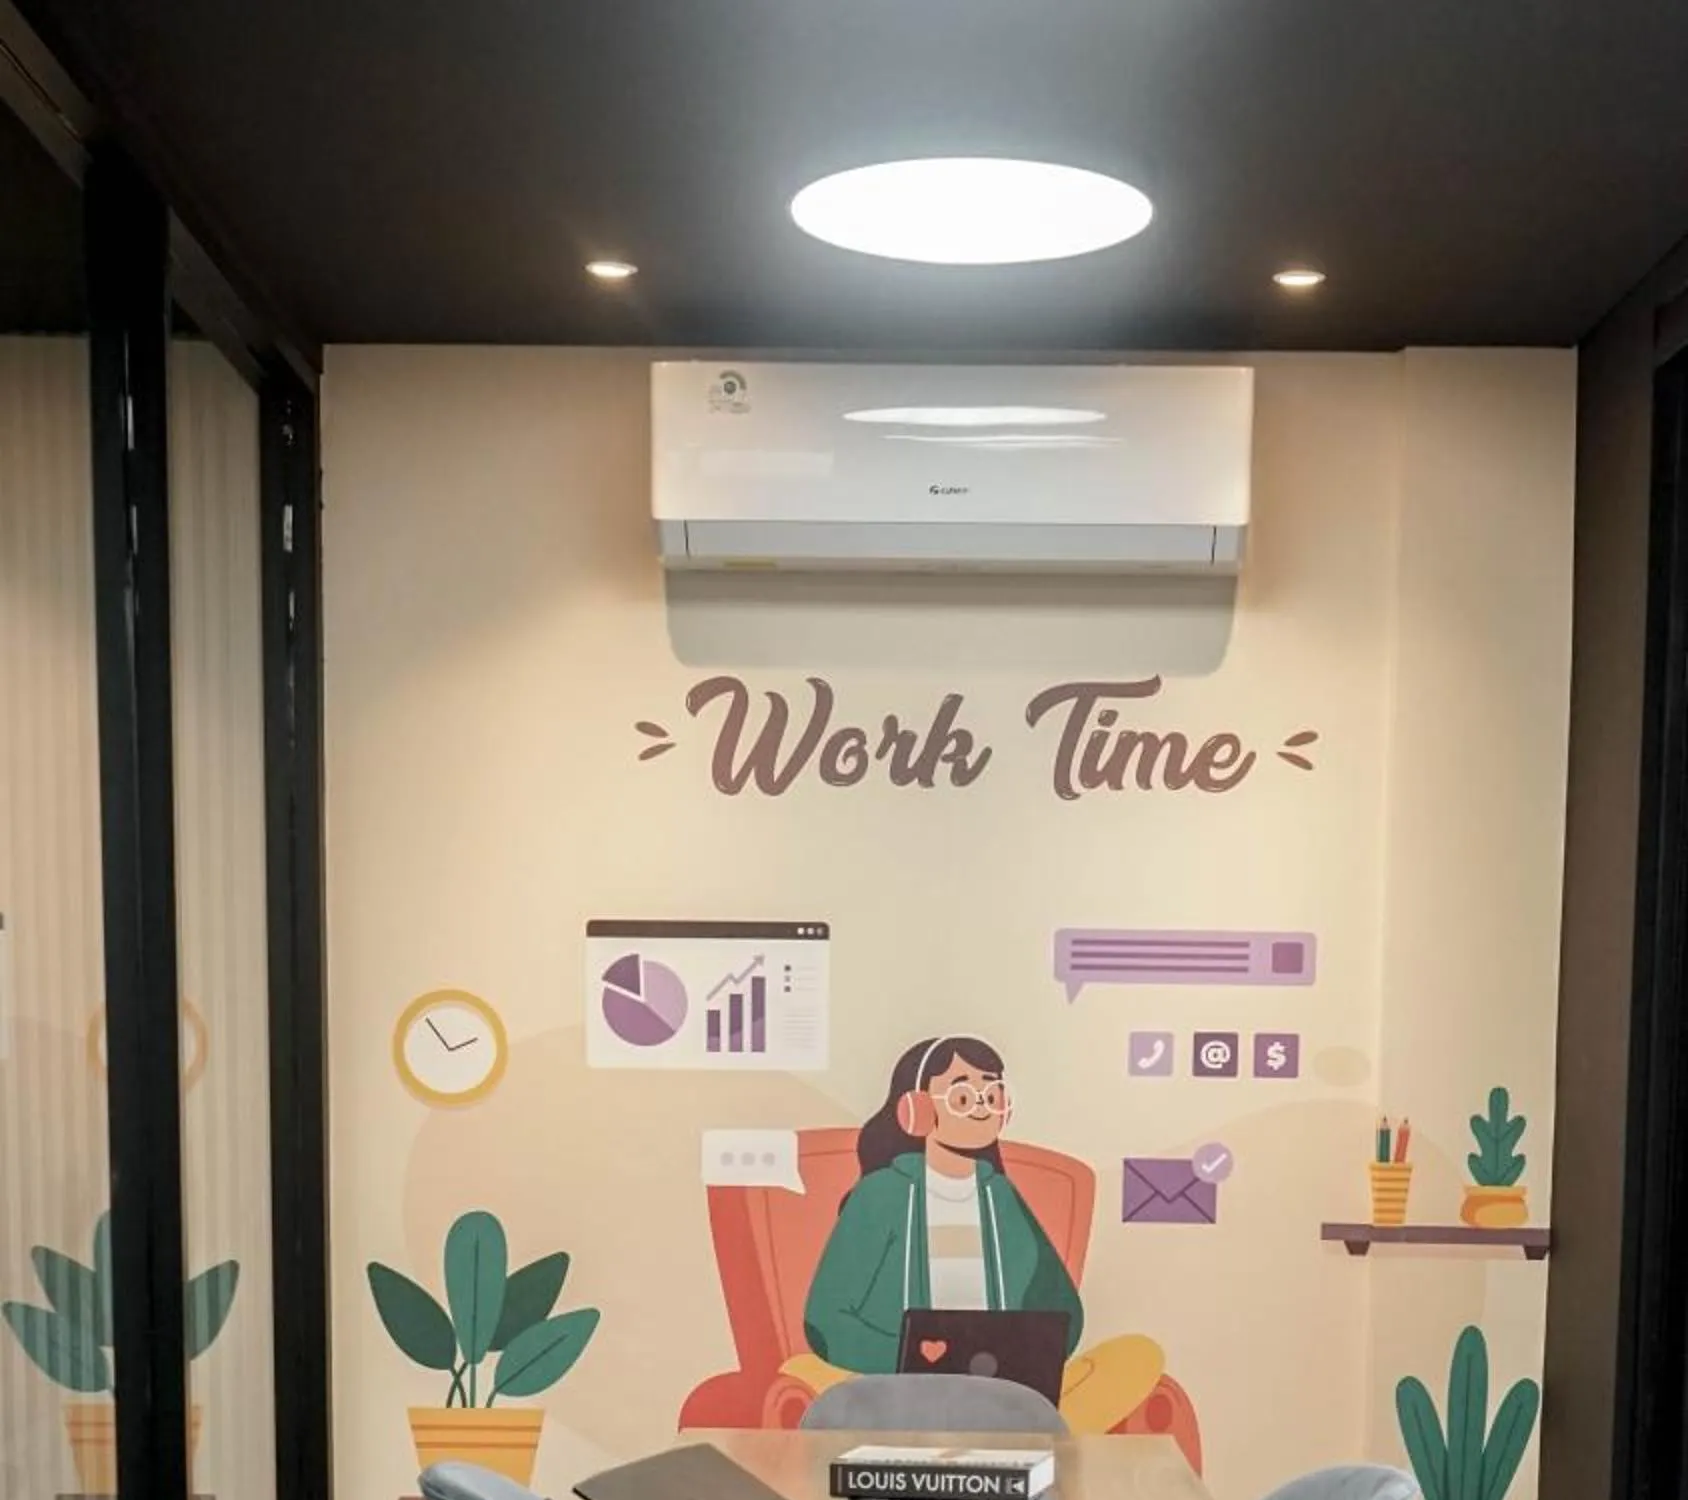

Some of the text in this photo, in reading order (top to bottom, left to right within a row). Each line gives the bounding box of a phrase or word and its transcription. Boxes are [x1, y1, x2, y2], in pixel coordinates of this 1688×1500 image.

[685, 674, 1257, 799] Work Time
[848, 1471, 1000, 1494] LOUIS VUITTON
